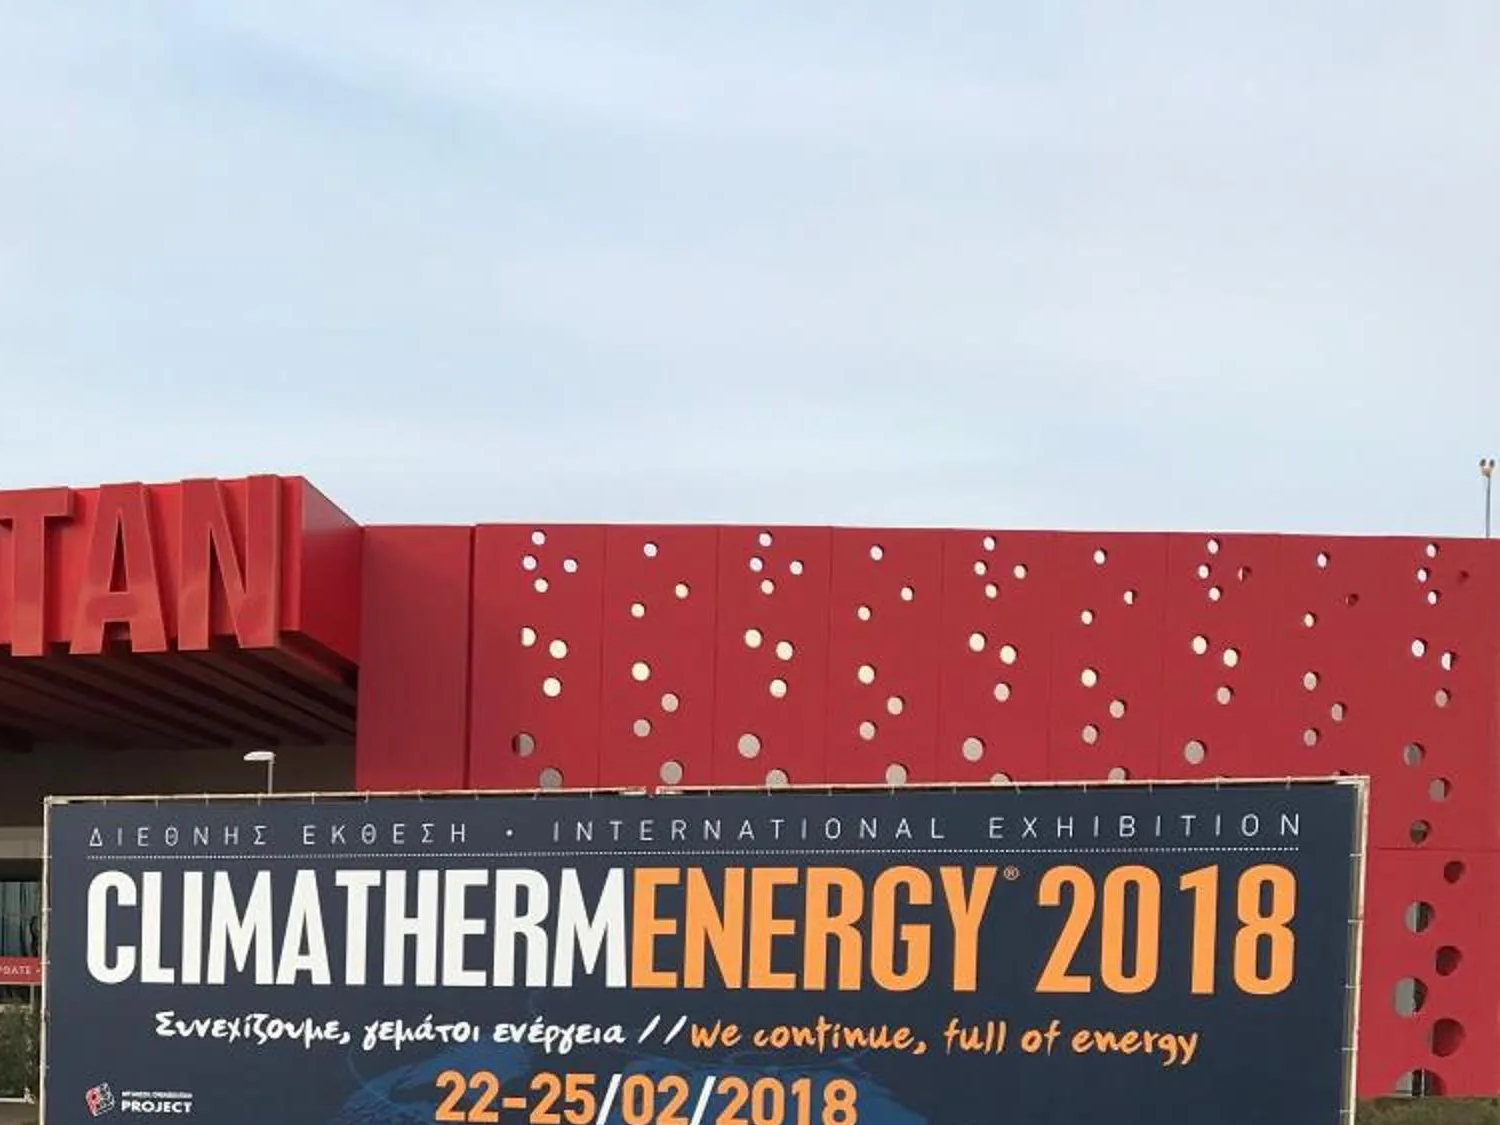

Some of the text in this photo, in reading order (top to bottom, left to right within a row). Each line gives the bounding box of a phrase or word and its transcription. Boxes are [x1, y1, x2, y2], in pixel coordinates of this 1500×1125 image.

[88, 813, 1301, 848] ΔΙΕΘΝΗΣ ΕΚΘΕΣΗ INTERNATIONAL EXHIBITION
[1035, 864, 1298, 995] 2018
[154, 1010, 351, 1048] Συνεχίζουμε,
[362, 1014, 480, 1050] γεμάτοι
[492, 1014, 626, 1054] ενέργεια
[752, 1016, 928, 1055] continue,
[943, 1018, 1008, 1056] full
[1020, 1020, 1062, 1055] of
[1071, 1025, 1199, 1066] energy
[121, 1100, 193, 1113] PROJECT
